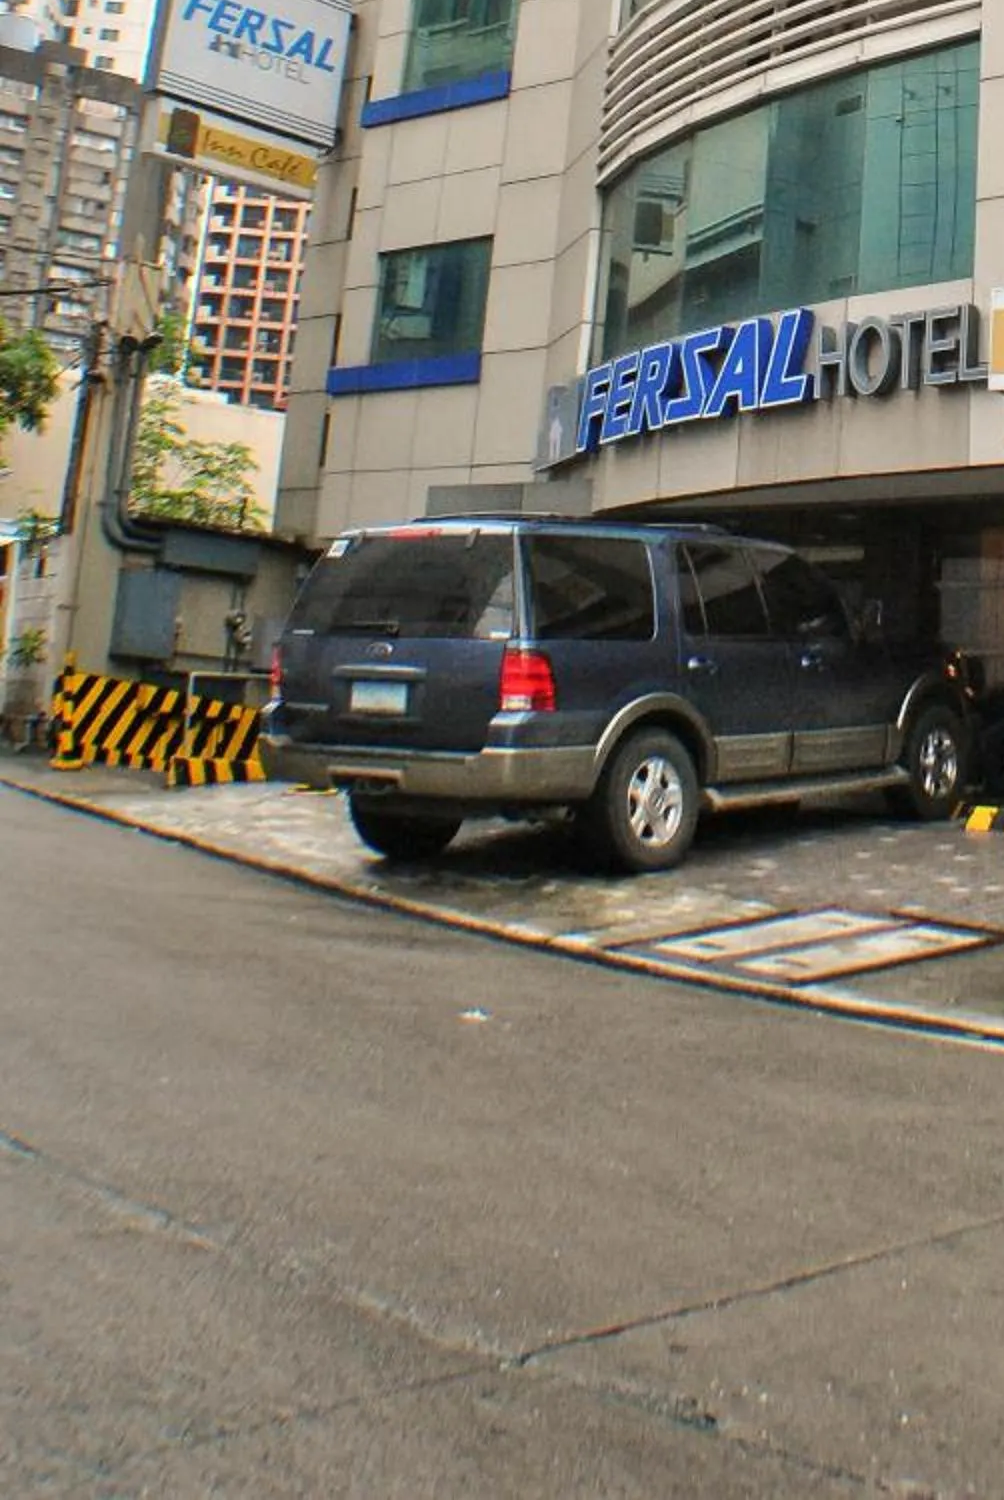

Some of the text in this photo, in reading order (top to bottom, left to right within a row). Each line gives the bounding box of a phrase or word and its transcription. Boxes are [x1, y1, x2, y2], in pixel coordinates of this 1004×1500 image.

[239, 45, 312, 85] HOTEL
[203, 130, 243, 159] Inn
[576, 303, 988, 453] FERSAL HOTEL
